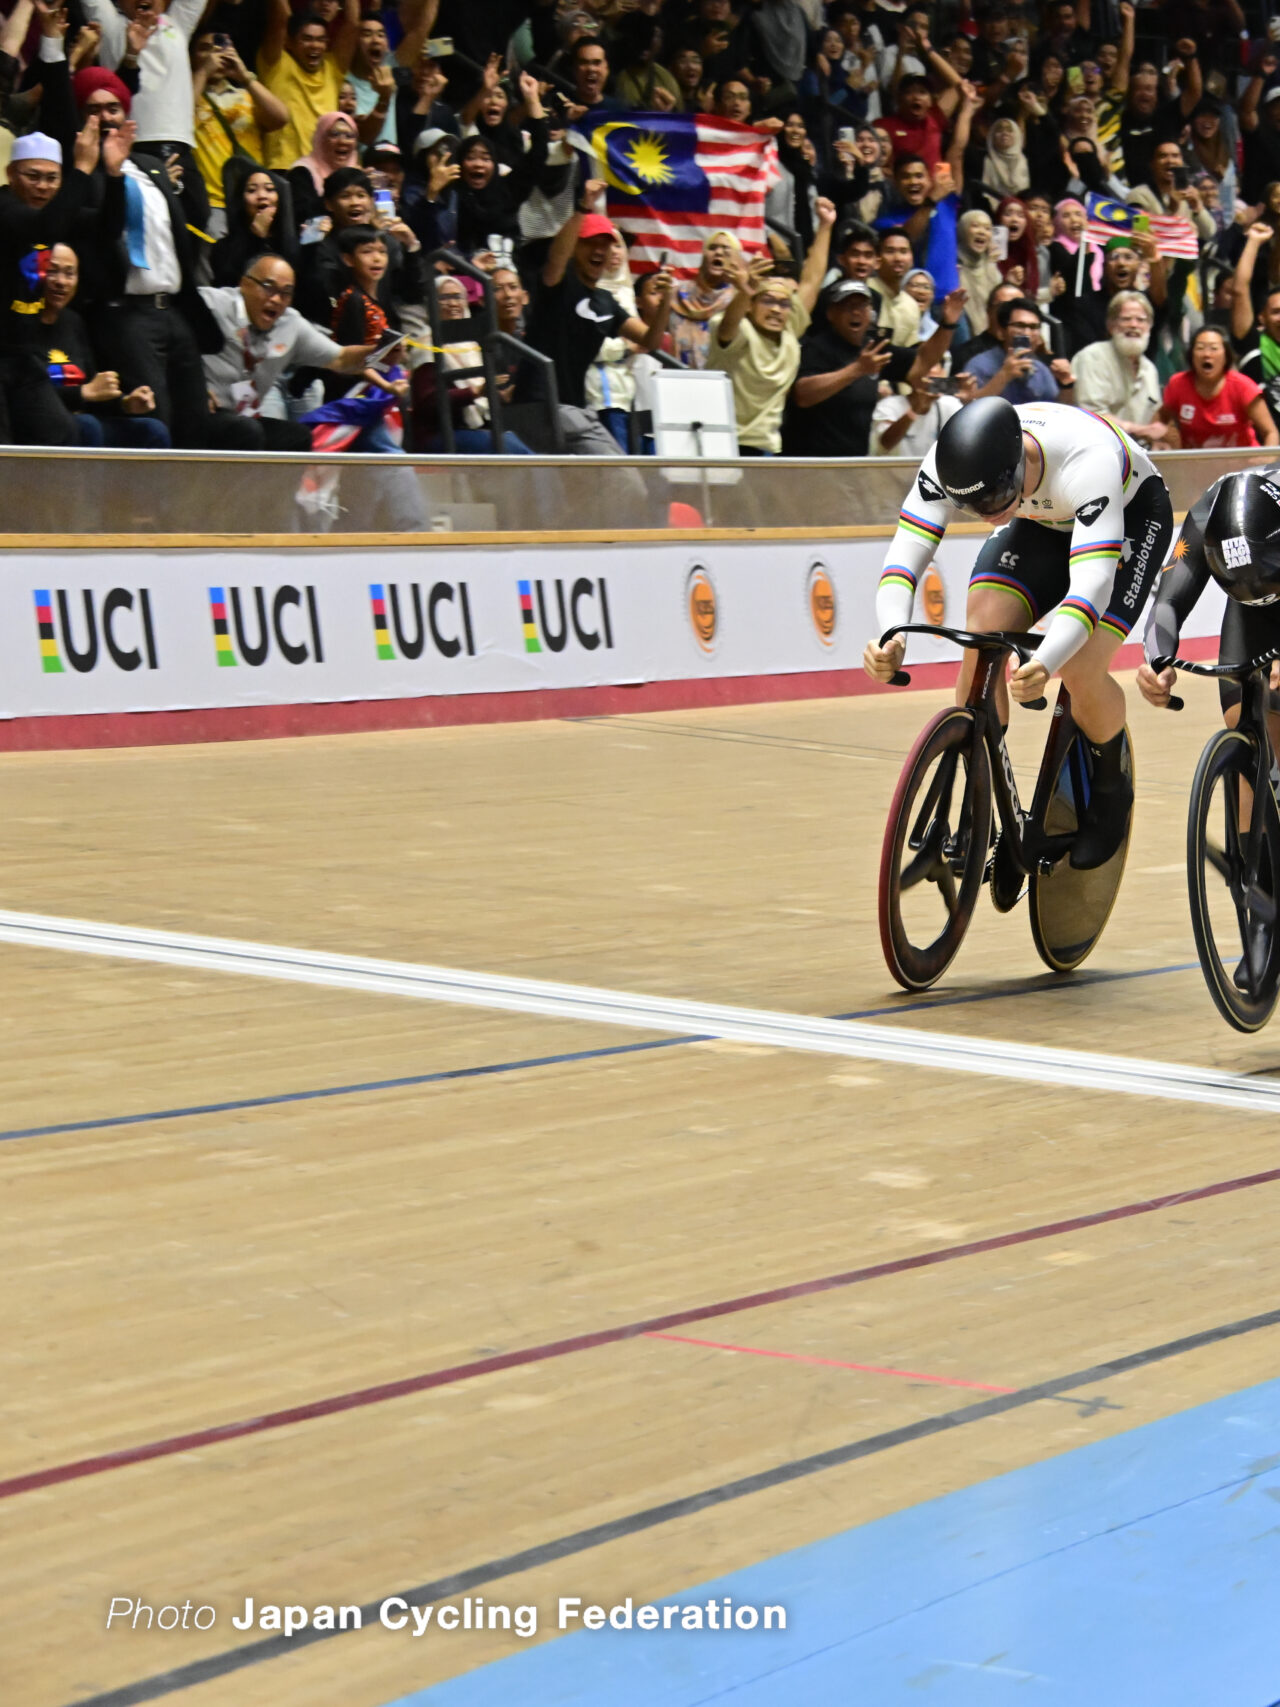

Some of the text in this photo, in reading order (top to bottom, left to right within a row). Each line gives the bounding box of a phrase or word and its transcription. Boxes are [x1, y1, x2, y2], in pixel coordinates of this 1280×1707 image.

[946, 481, 985, 496] POWERADE
[1123, 519, 1163, 609] Staatsloterij
[57, 587, 160, 672] UCI
[230, 585, 325, 667] UCI
[389, 581, 477, 660] UCI
[535, 577, 616, 653] UCI
